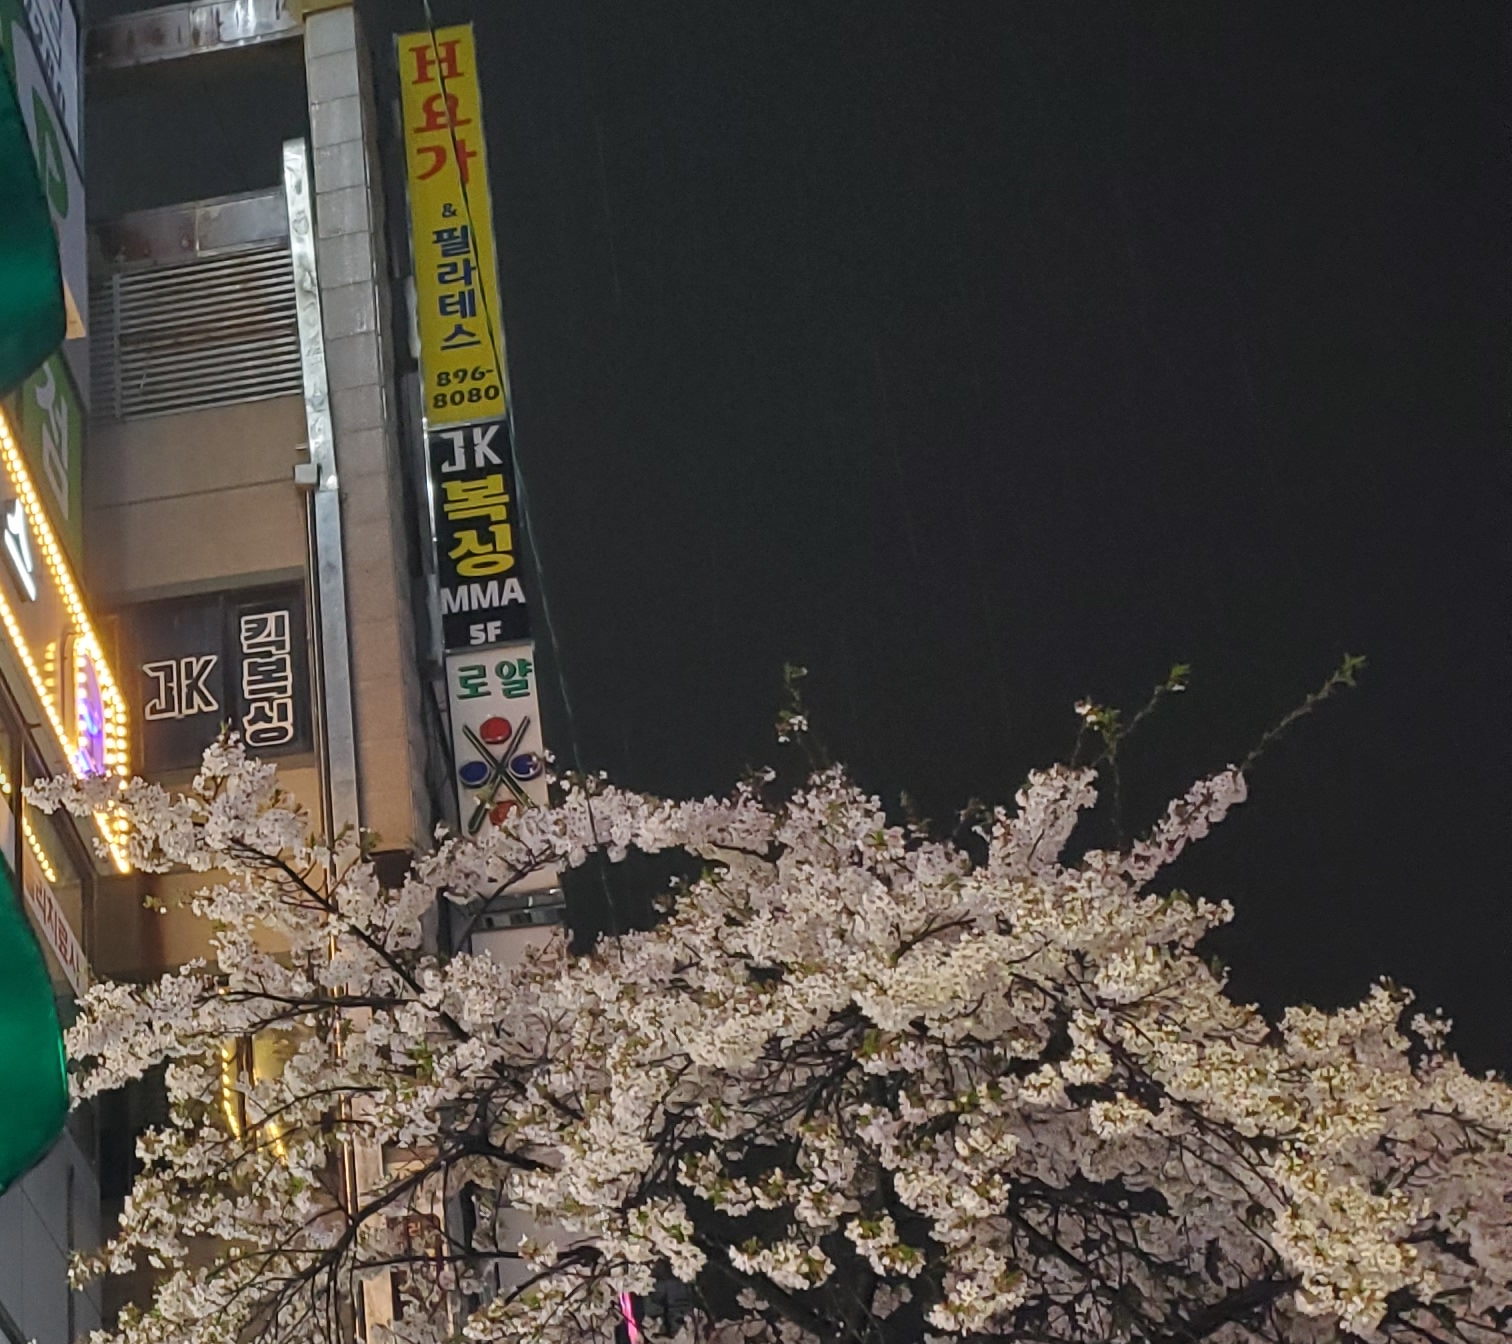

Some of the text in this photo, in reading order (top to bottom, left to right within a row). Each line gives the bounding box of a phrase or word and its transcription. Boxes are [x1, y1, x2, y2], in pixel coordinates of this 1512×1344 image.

[431, 224, 481, 351] 필라테스
[432, 385, 500, 409] 8080
[440, 425, 503, 473] JK
[441, 474, 515, 577] 복싱
[440, 577, 526, 615] MMA
[469, 620, 502, 645] 5F
[142, 655, 219, 721] JK
[239, 610, 294, 747] 킥복싱
[455, 658, 533, 700] 로얄
